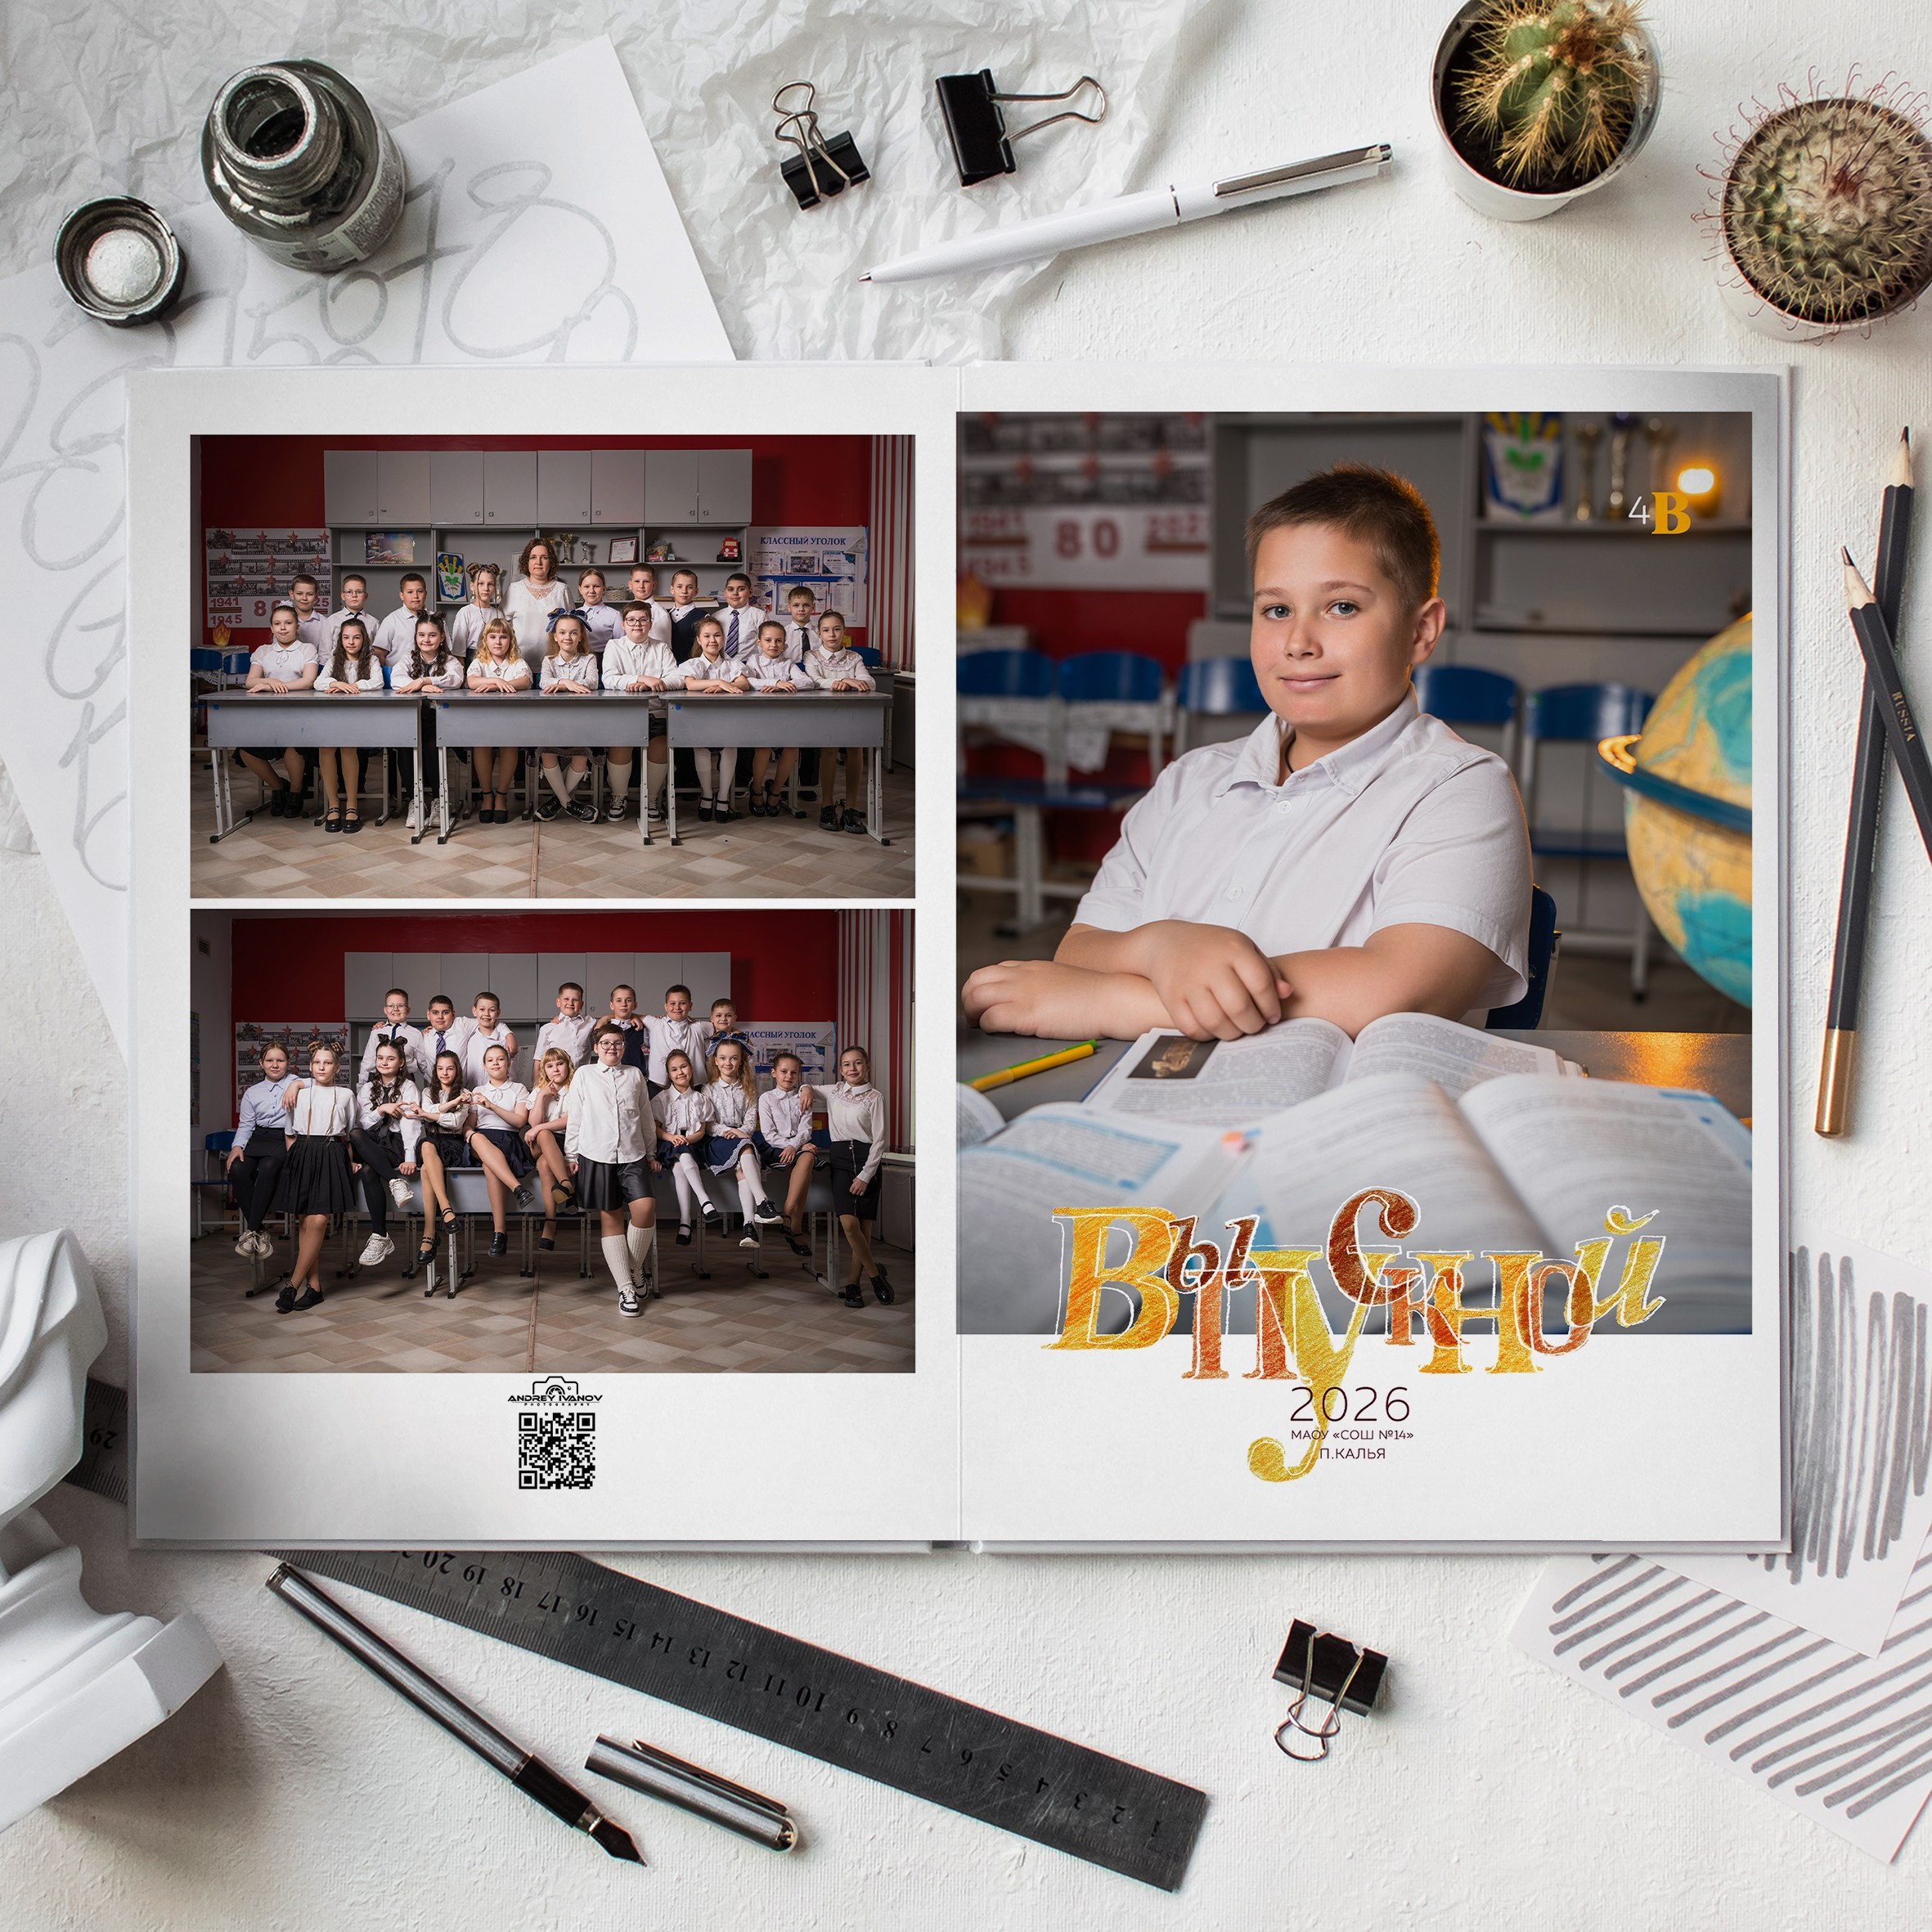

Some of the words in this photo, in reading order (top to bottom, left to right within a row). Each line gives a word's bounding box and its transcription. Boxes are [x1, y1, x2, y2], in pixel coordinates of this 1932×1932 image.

[760, 537, 809, 546] КЛАССНЫЙ
[811, 537, 846, 546] УГОЛОК
[1055, 517, 1121, 559] 80
[210, 597, 239, 608] 1941
[210, 614, 242, 624] 1945
[1892, 691, 1916, 742] RUSSIA
[744, 1030, 783, 1039] ЛАССНЫЙ
[784, 1031, 816, 1039] УГОЛОК
[1290, 1386, 1410, 1422] 2026
[90, 1428, 117, 1449] 29
[1291, 1430, 1329, 1440] МАОУ
[1332, 1430, 1374, 1440] «СОШ
[1379, 1430, 1414, 1440] №14»
[1319, 1448, 1386, 1459] П.КАЛЬЯ
[423, 1551, 456, 1575] 20
[462, 1564, 489, 1585] 19
[500, 1576, 527, 1599] 18
[537, 1591, 563, 1613] 17
[575, 1604, 599, 1626] 16
[613, 1618, 637, 1640] 15
[650, 1632, 673, 1653] 14
[689, 1647, 712, 1668] 13
[726, 1660, 750, 1682] 12
[763, 1674, 786, 1696] 11
[795, 1685, 826, 1713] 10
[846, 1707, 859, 1724] 9
[883, 1719, 899, 1739] 8
[920, 1735, 934, 1754] 7
[959, 1748, 973, 1766] 6
[996, 1763, 1013, 1781] 5
[1036, 1777, 1049, 1794] 4
[1073, 1792, 1088, 1810] 3
[1112, 1805, 1126, 1824] 2
